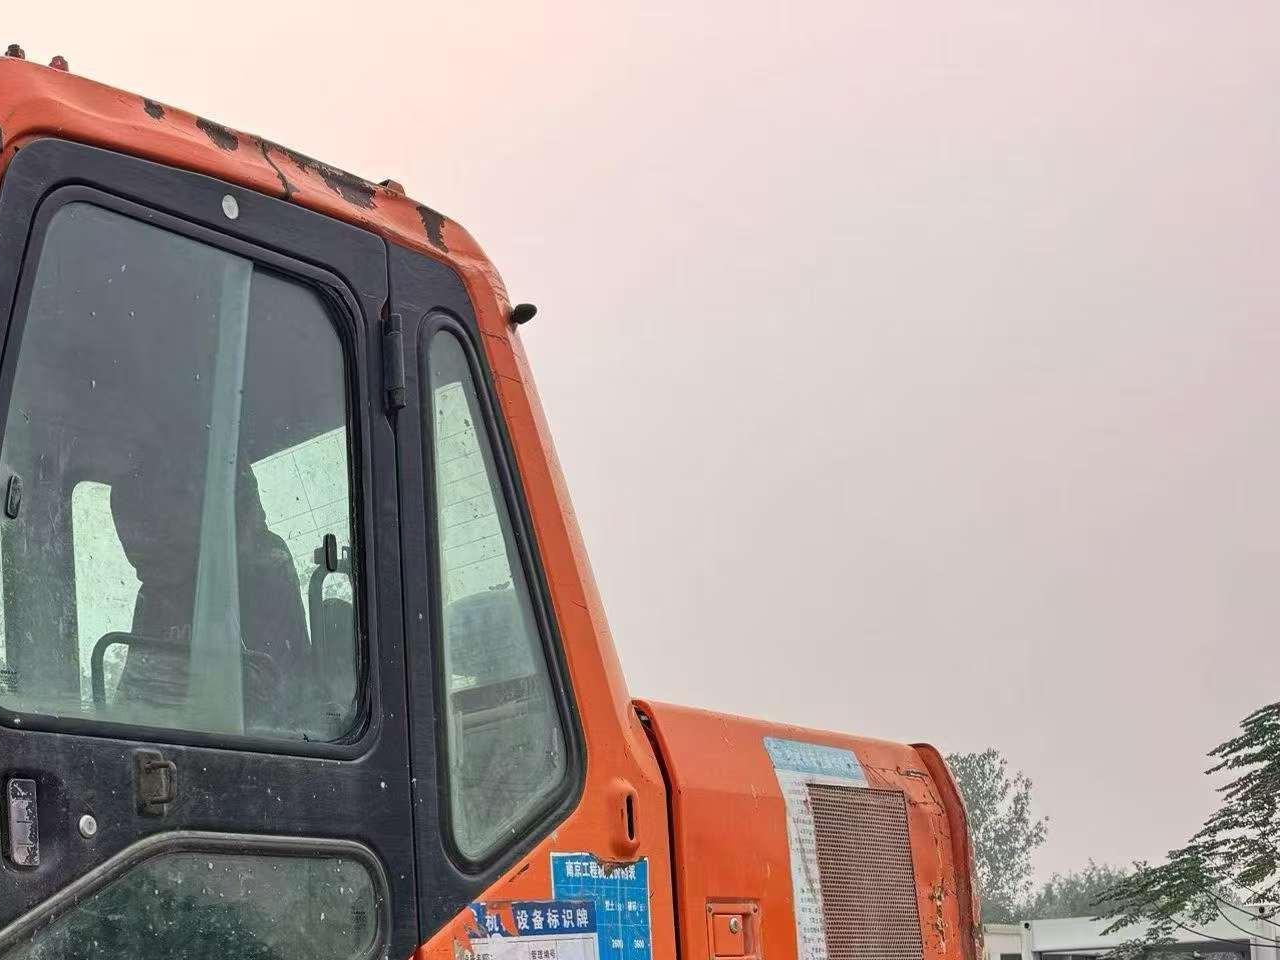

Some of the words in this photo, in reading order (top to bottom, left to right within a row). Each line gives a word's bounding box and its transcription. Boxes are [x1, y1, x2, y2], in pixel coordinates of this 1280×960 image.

[565, 860, 636, 880] 南京工程机价格表
[485, 908, 589, 932] 机设备标识牌
